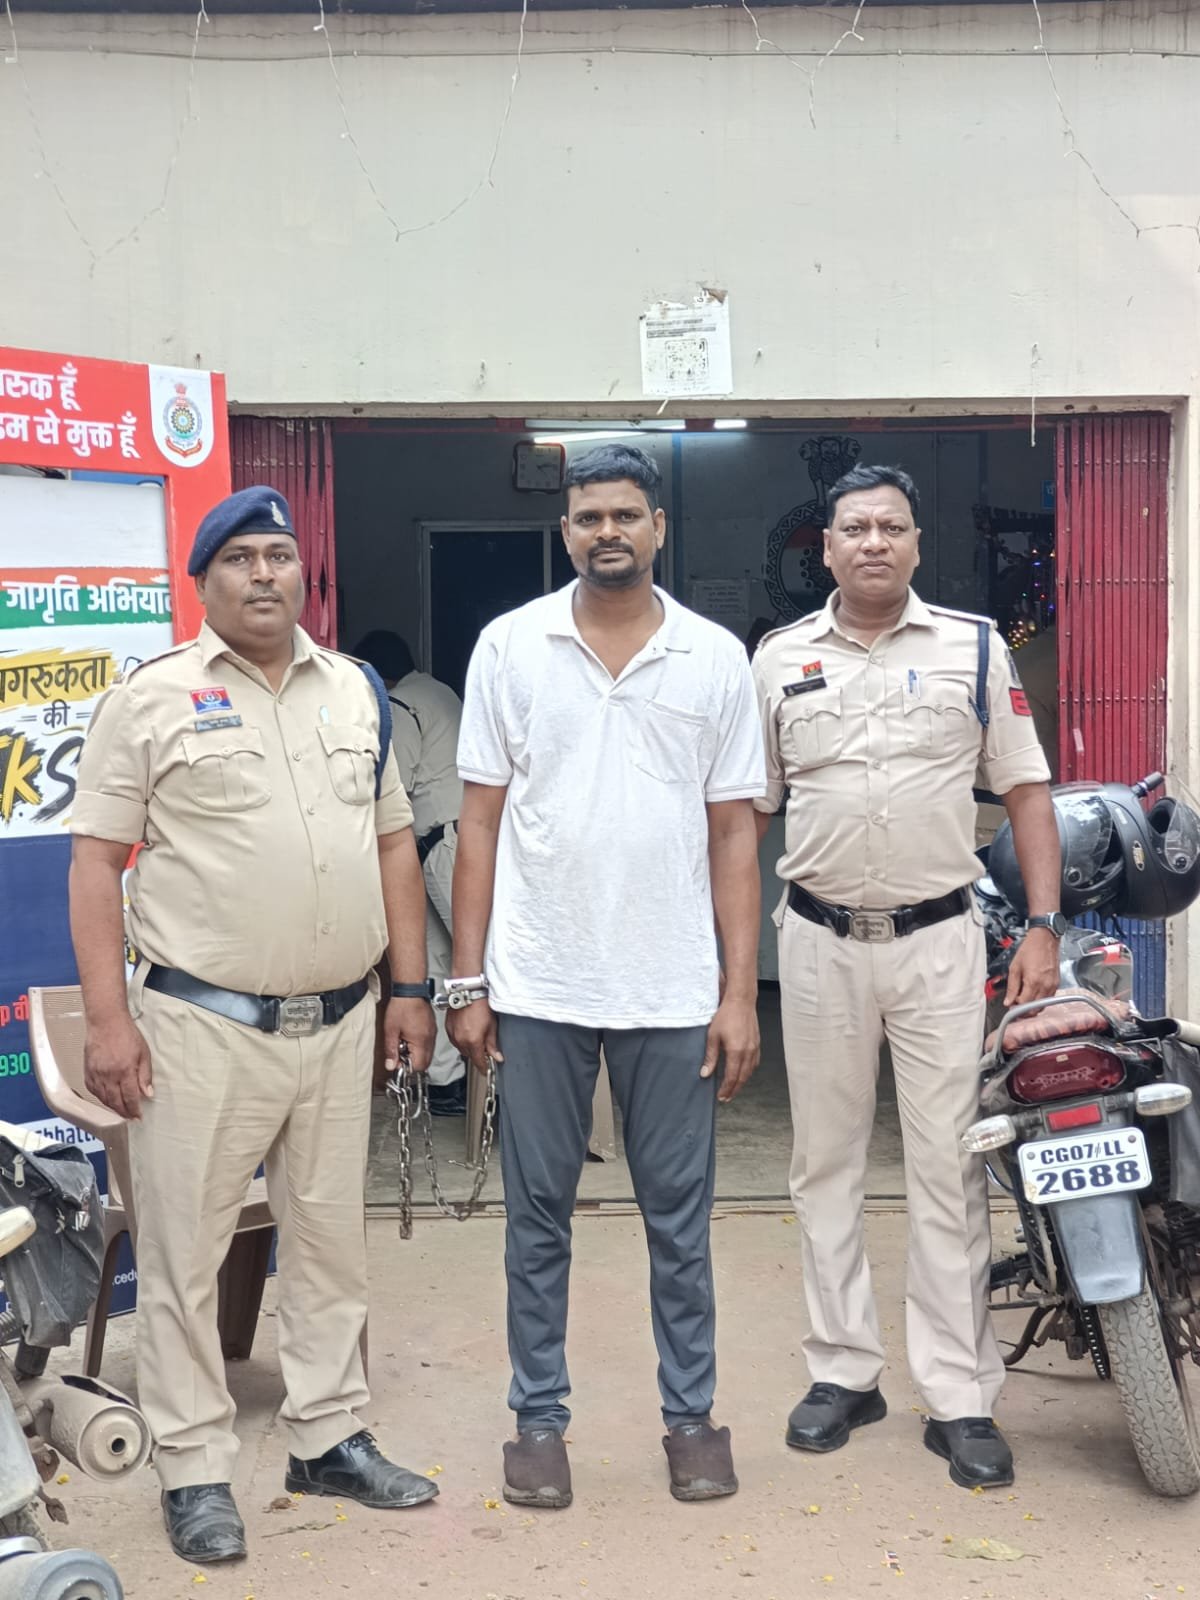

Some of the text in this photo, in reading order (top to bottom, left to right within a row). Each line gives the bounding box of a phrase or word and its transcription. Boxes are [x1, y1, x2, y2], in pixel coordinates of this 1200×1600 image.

[57, 361, 82, 412] हूँ
[33, 408, 61, 445] से
[64, 419, 114, 457] मुक्त
[117, 410, 141, 459] हूँ
[2, 575, 80, 624] जागृति
[43, 699, 71, 728] की
[1036, 1160, 1141, 1196] 2688
